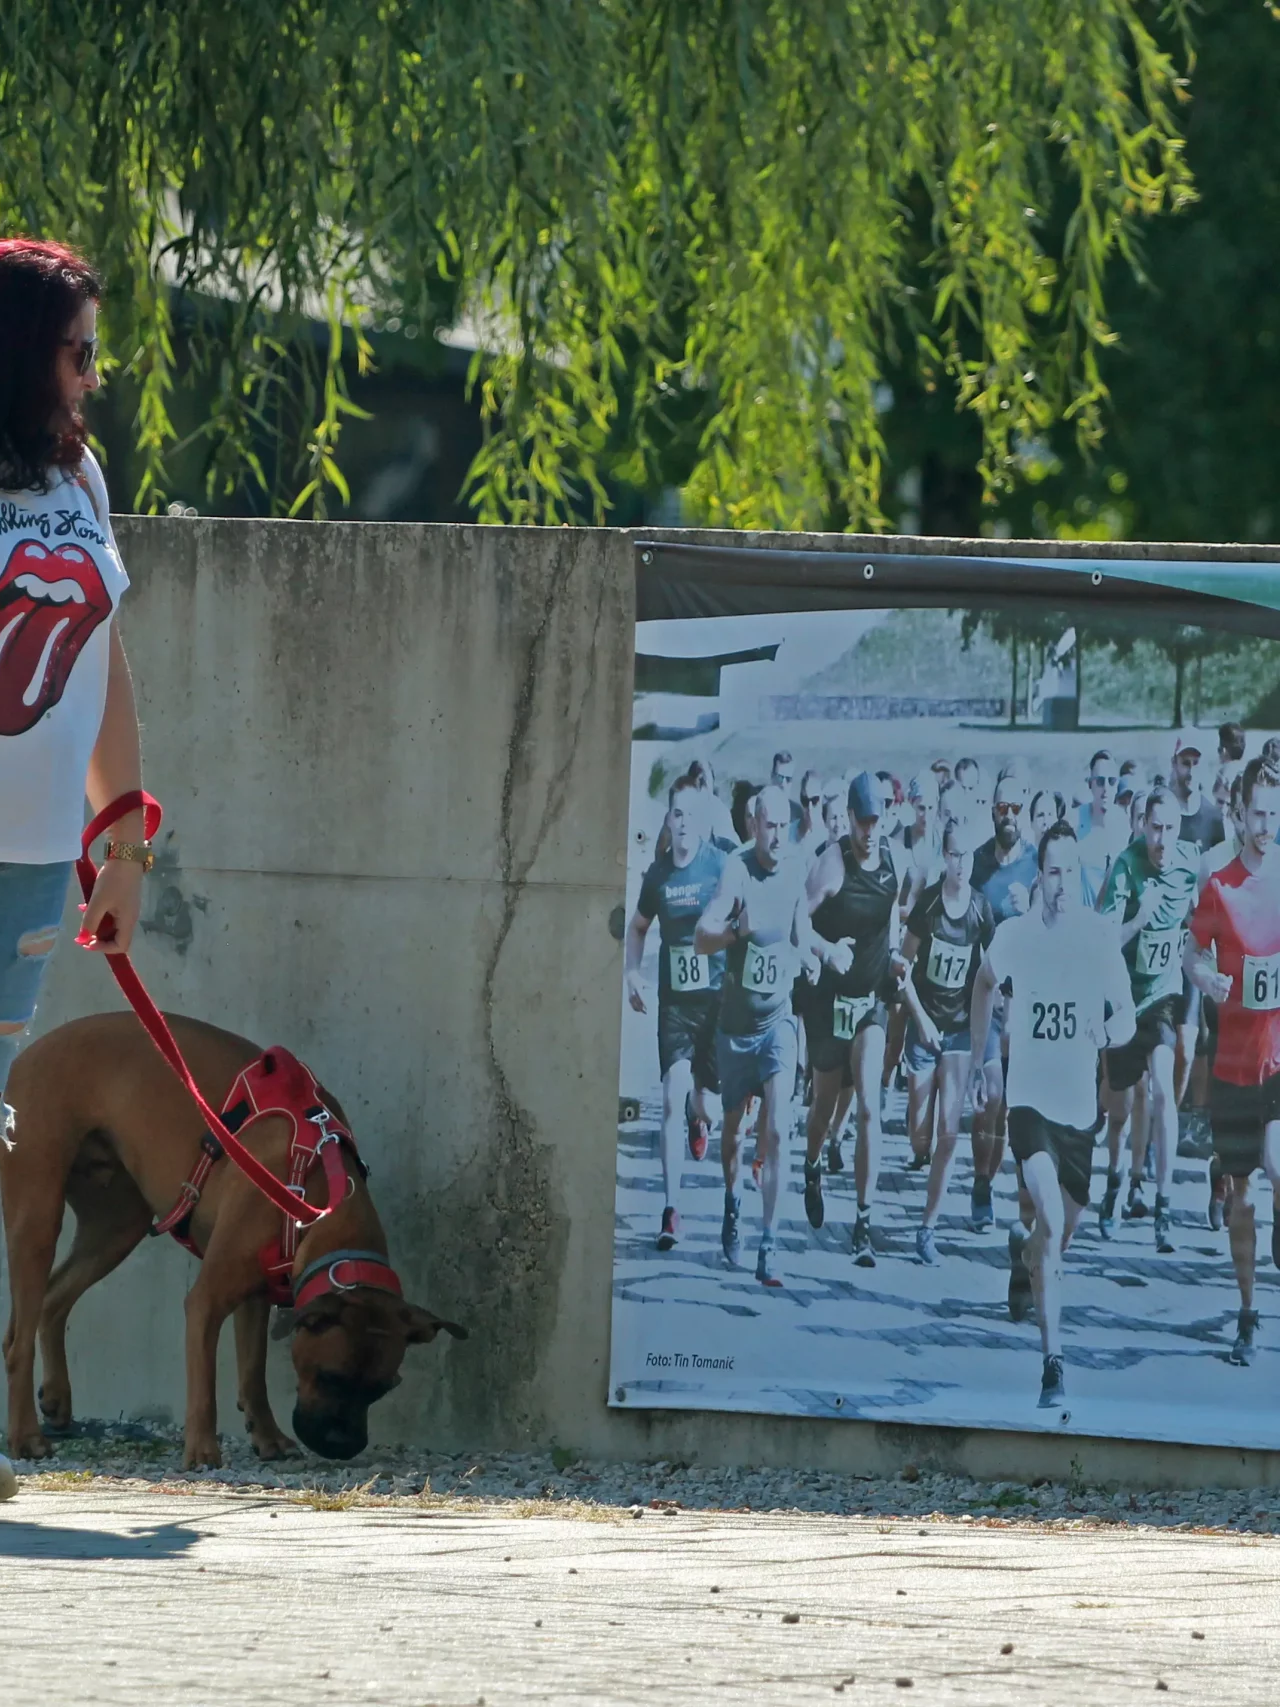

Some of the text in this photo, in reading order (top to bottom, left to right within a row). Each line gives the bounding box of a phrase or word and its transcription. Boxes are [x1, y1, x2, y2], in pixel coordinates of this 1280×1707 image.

[53, 509, 109, 546] Stone
[677, 954, 700, 984] 38
[752, 954, 777, 985] 35
[933, 952, 966, 982] 117
[1148, 942, 1170, 969] 79
[1032, 1001, 1077, 1042] 235
[645, 1352, 735, 1370] Foto: Tin Tomanić
